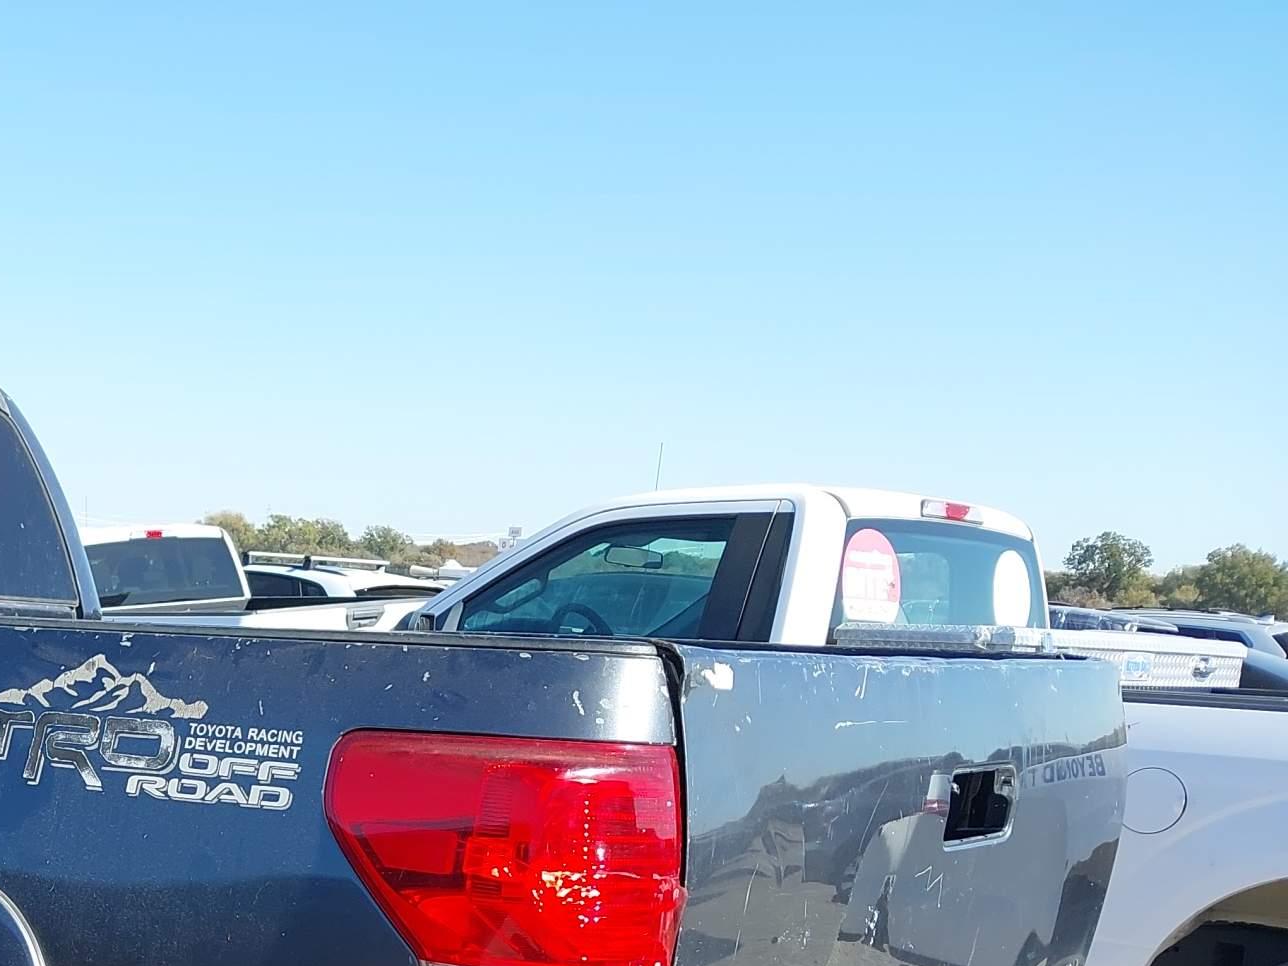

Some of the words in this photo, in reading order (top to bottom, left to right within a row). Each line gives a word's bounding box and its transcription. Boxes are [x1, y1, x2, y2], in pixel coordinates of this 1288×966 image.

[189, 723, 242, 739] TOYOTA
[247, 728, 303, 744] RACING
[184, 737, 301, 759] DEVELOPMENT
[179, 752, 301, 784] OFF
[126, 775, 292, 811] ROAD
